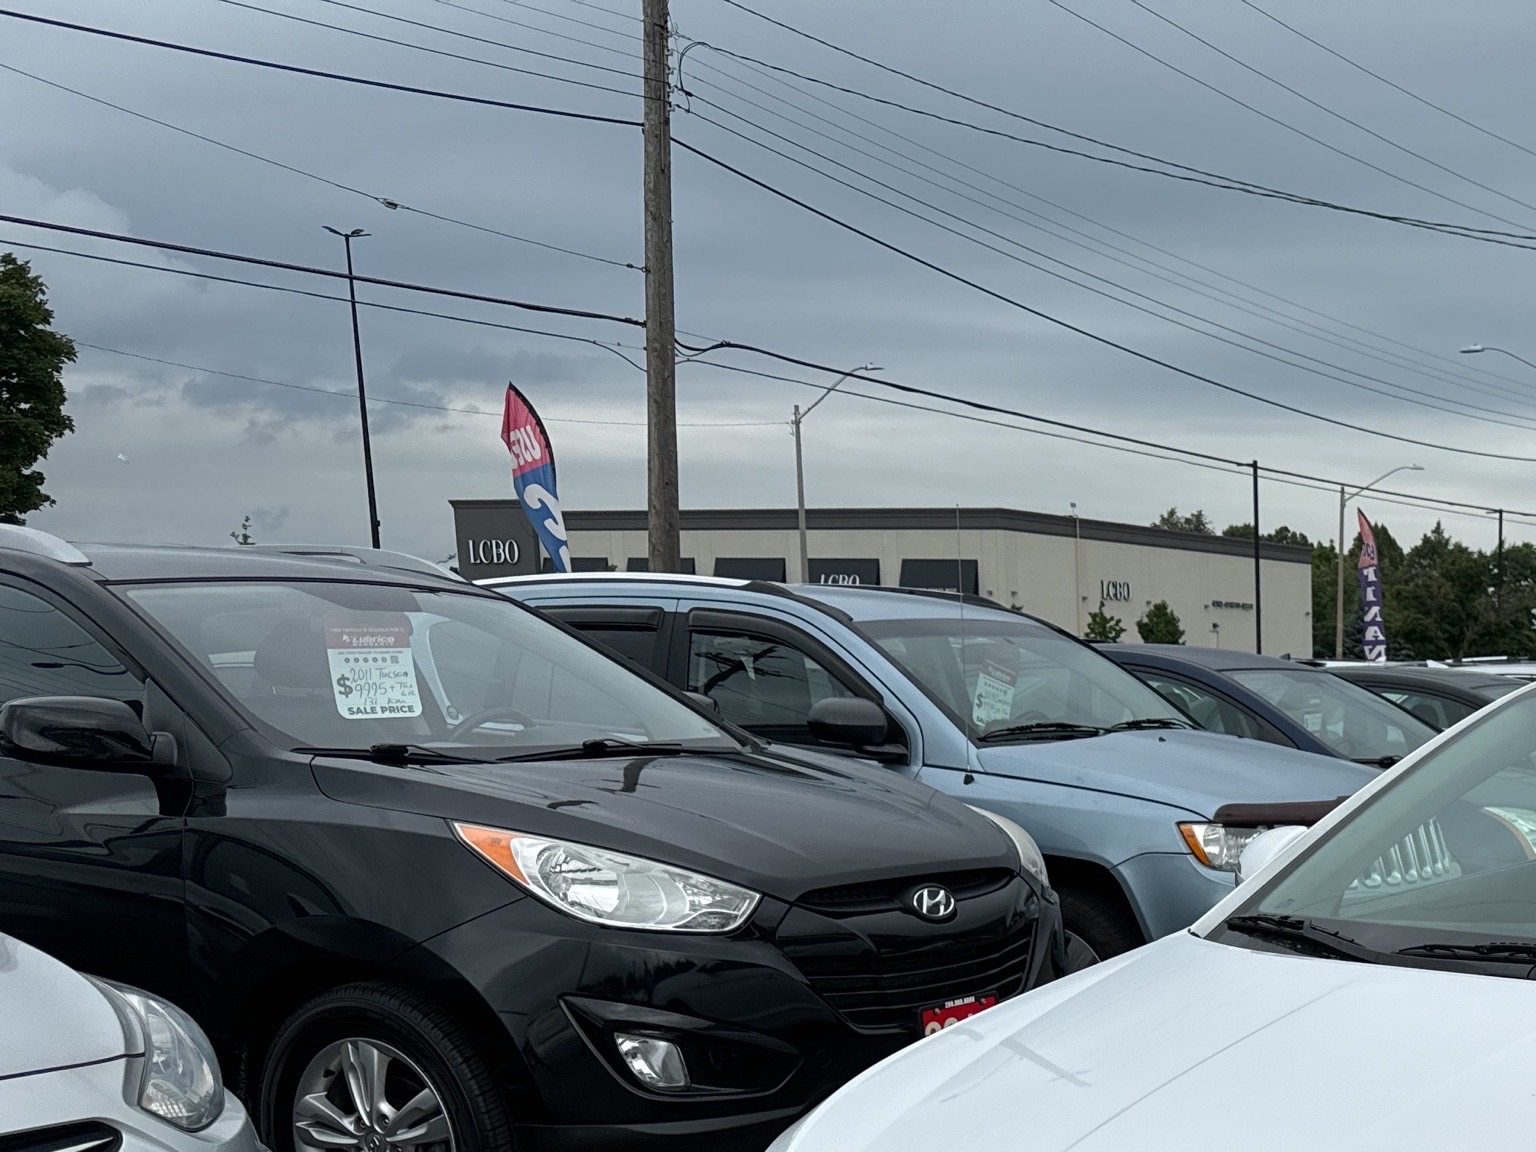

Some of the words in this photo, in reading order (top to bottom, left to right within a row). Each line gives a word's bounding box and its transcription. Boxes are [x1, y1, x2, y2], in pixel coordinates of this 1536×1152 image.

[468, 538, 519, 565] LCBO
[1100, 580, 1131, 601] LCBO
[352, 634, 395, 643] Lubrico
[349, 667, 372, 684] 2011
[375, 668, 408, 680] Tucson
[336, 673, 354, 699] $
[354, 682, 388, 699] 9995
[347, 706, 378, 716] SALE
[380, 705, 416, 714] PRICE
